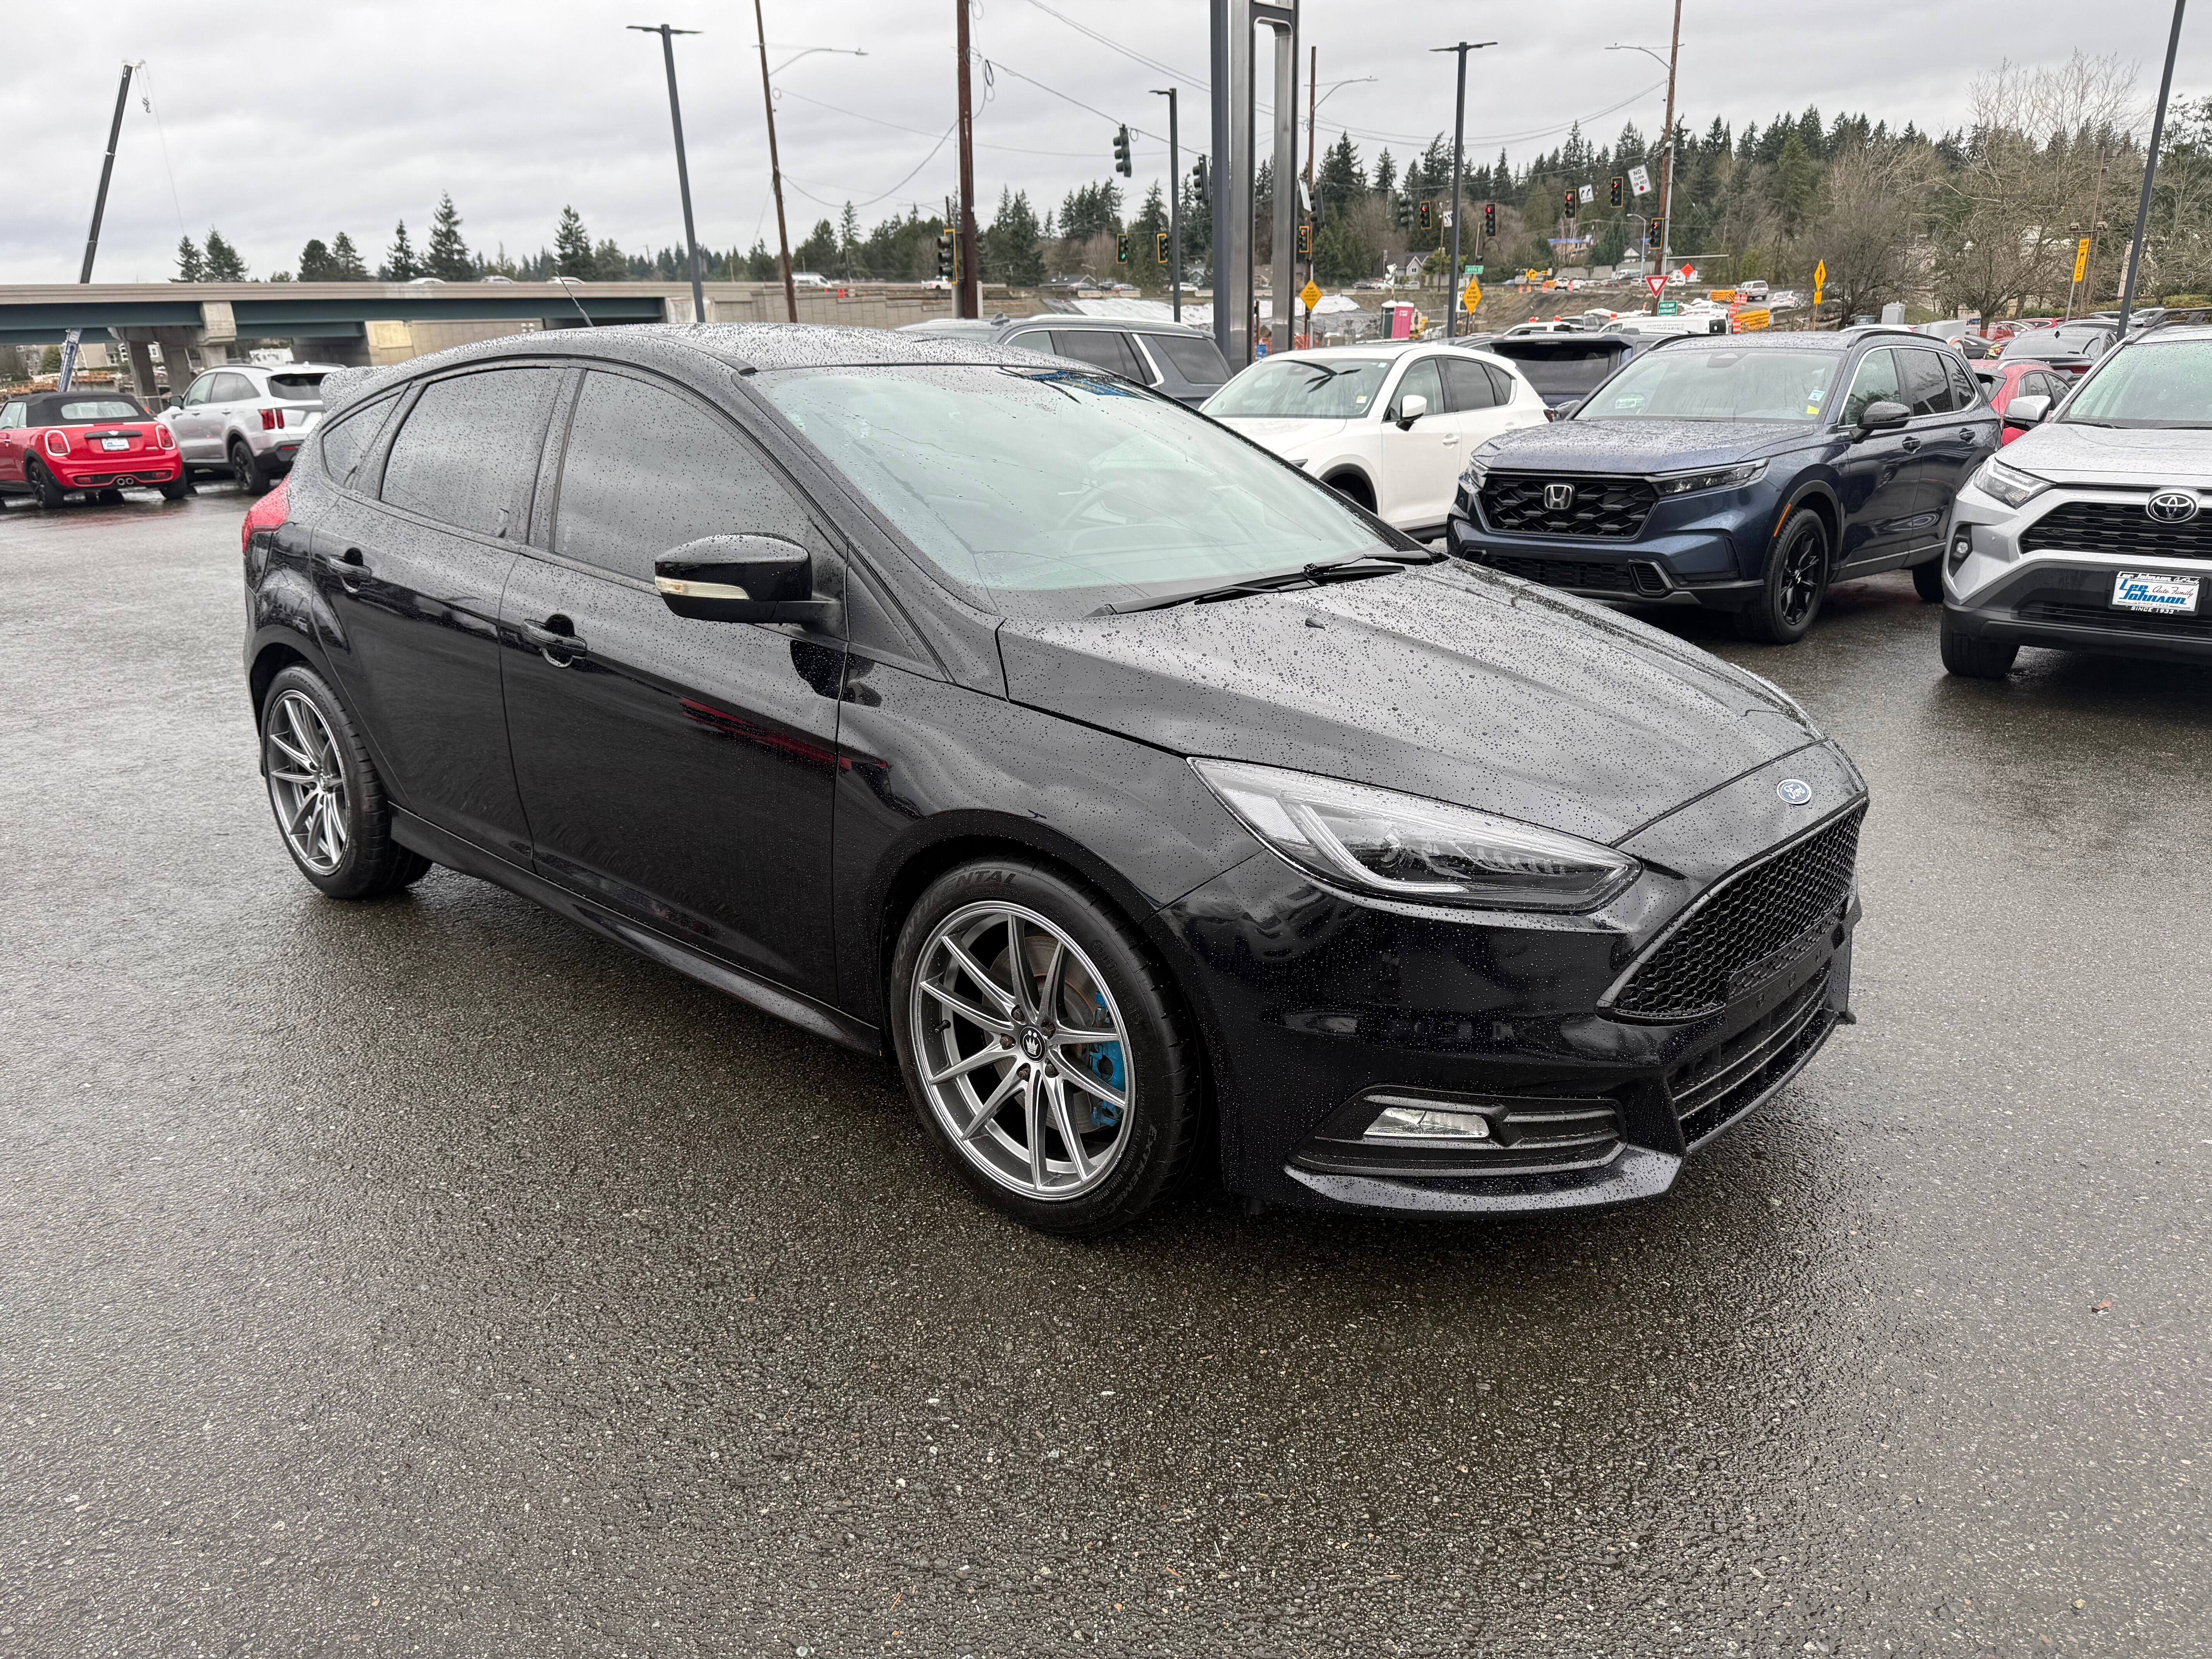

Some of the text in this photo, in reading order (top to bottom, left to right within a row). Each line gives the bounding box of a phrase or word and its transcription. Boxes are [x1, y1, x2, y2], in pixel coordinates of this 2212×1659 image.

[2077, 265, 2082, 273] 15
[2135, 573, 2171, 582] Johnson
[2119, 579, 2149, 592] Lee
[2152, 585, 2194, 598] Auto Family
[2119, 590, 2186, 605] Johnson
[1784, 784, 1806, 799] Ford
